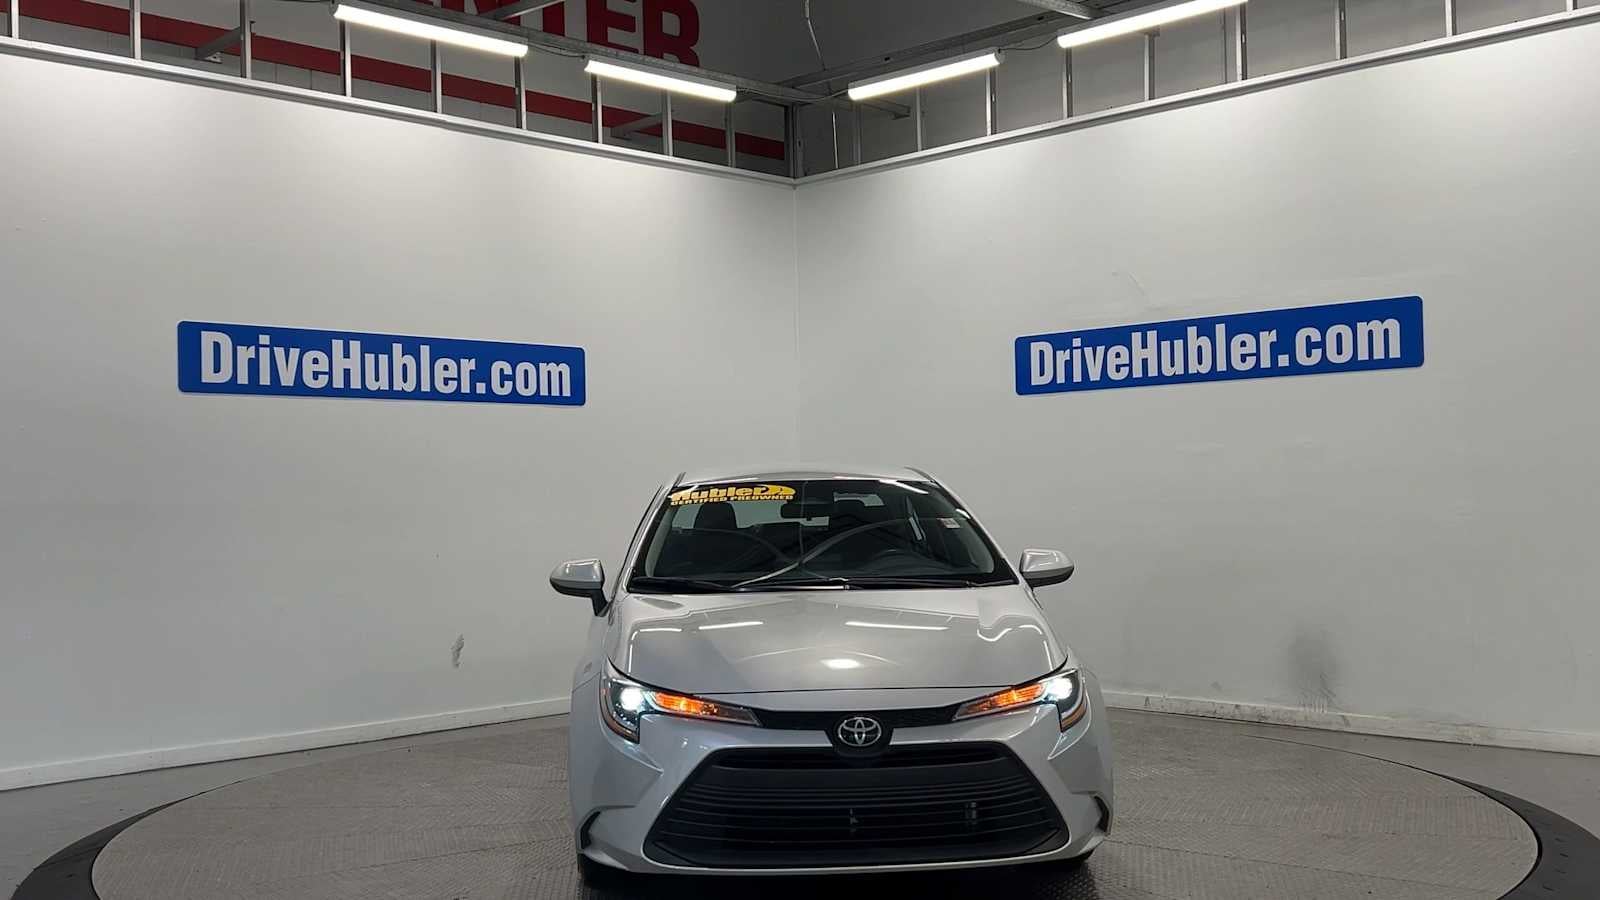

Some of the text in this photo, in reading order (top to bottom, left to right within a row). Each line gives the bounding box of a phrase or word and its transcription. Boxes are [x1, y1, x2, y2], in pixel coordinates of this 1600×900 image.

[200, 330, 571, 397] DriveHubler.com
[1029, 317, 1402, 386] DriveHubler.com
[670, 497, 728, 506] CERTIFIED
